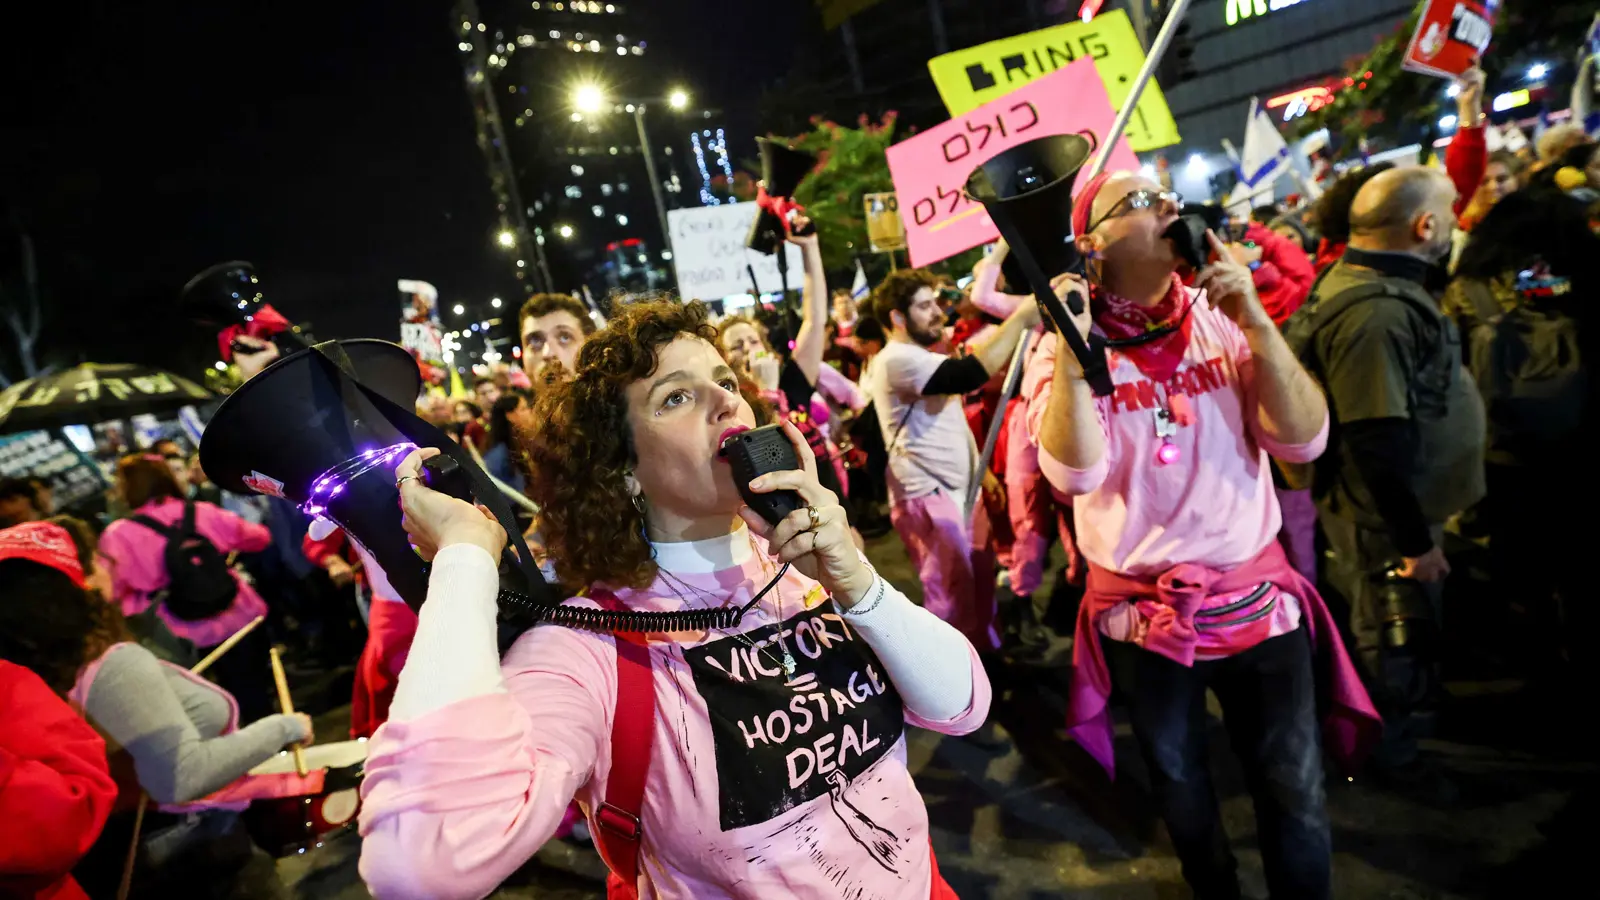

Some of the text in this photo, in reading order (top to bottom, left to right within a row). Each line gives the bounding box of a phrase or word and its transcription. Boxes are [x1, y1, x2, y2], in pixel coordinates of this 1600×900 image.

[965, 32, 1110, 92] BRING
[942, 101, 1039, 163] כולם
[704, 612, 854, 684] VICTORY
[737, 663, 886, 749] HOSTAGE
[785, 718, 881, 790] DEAL
